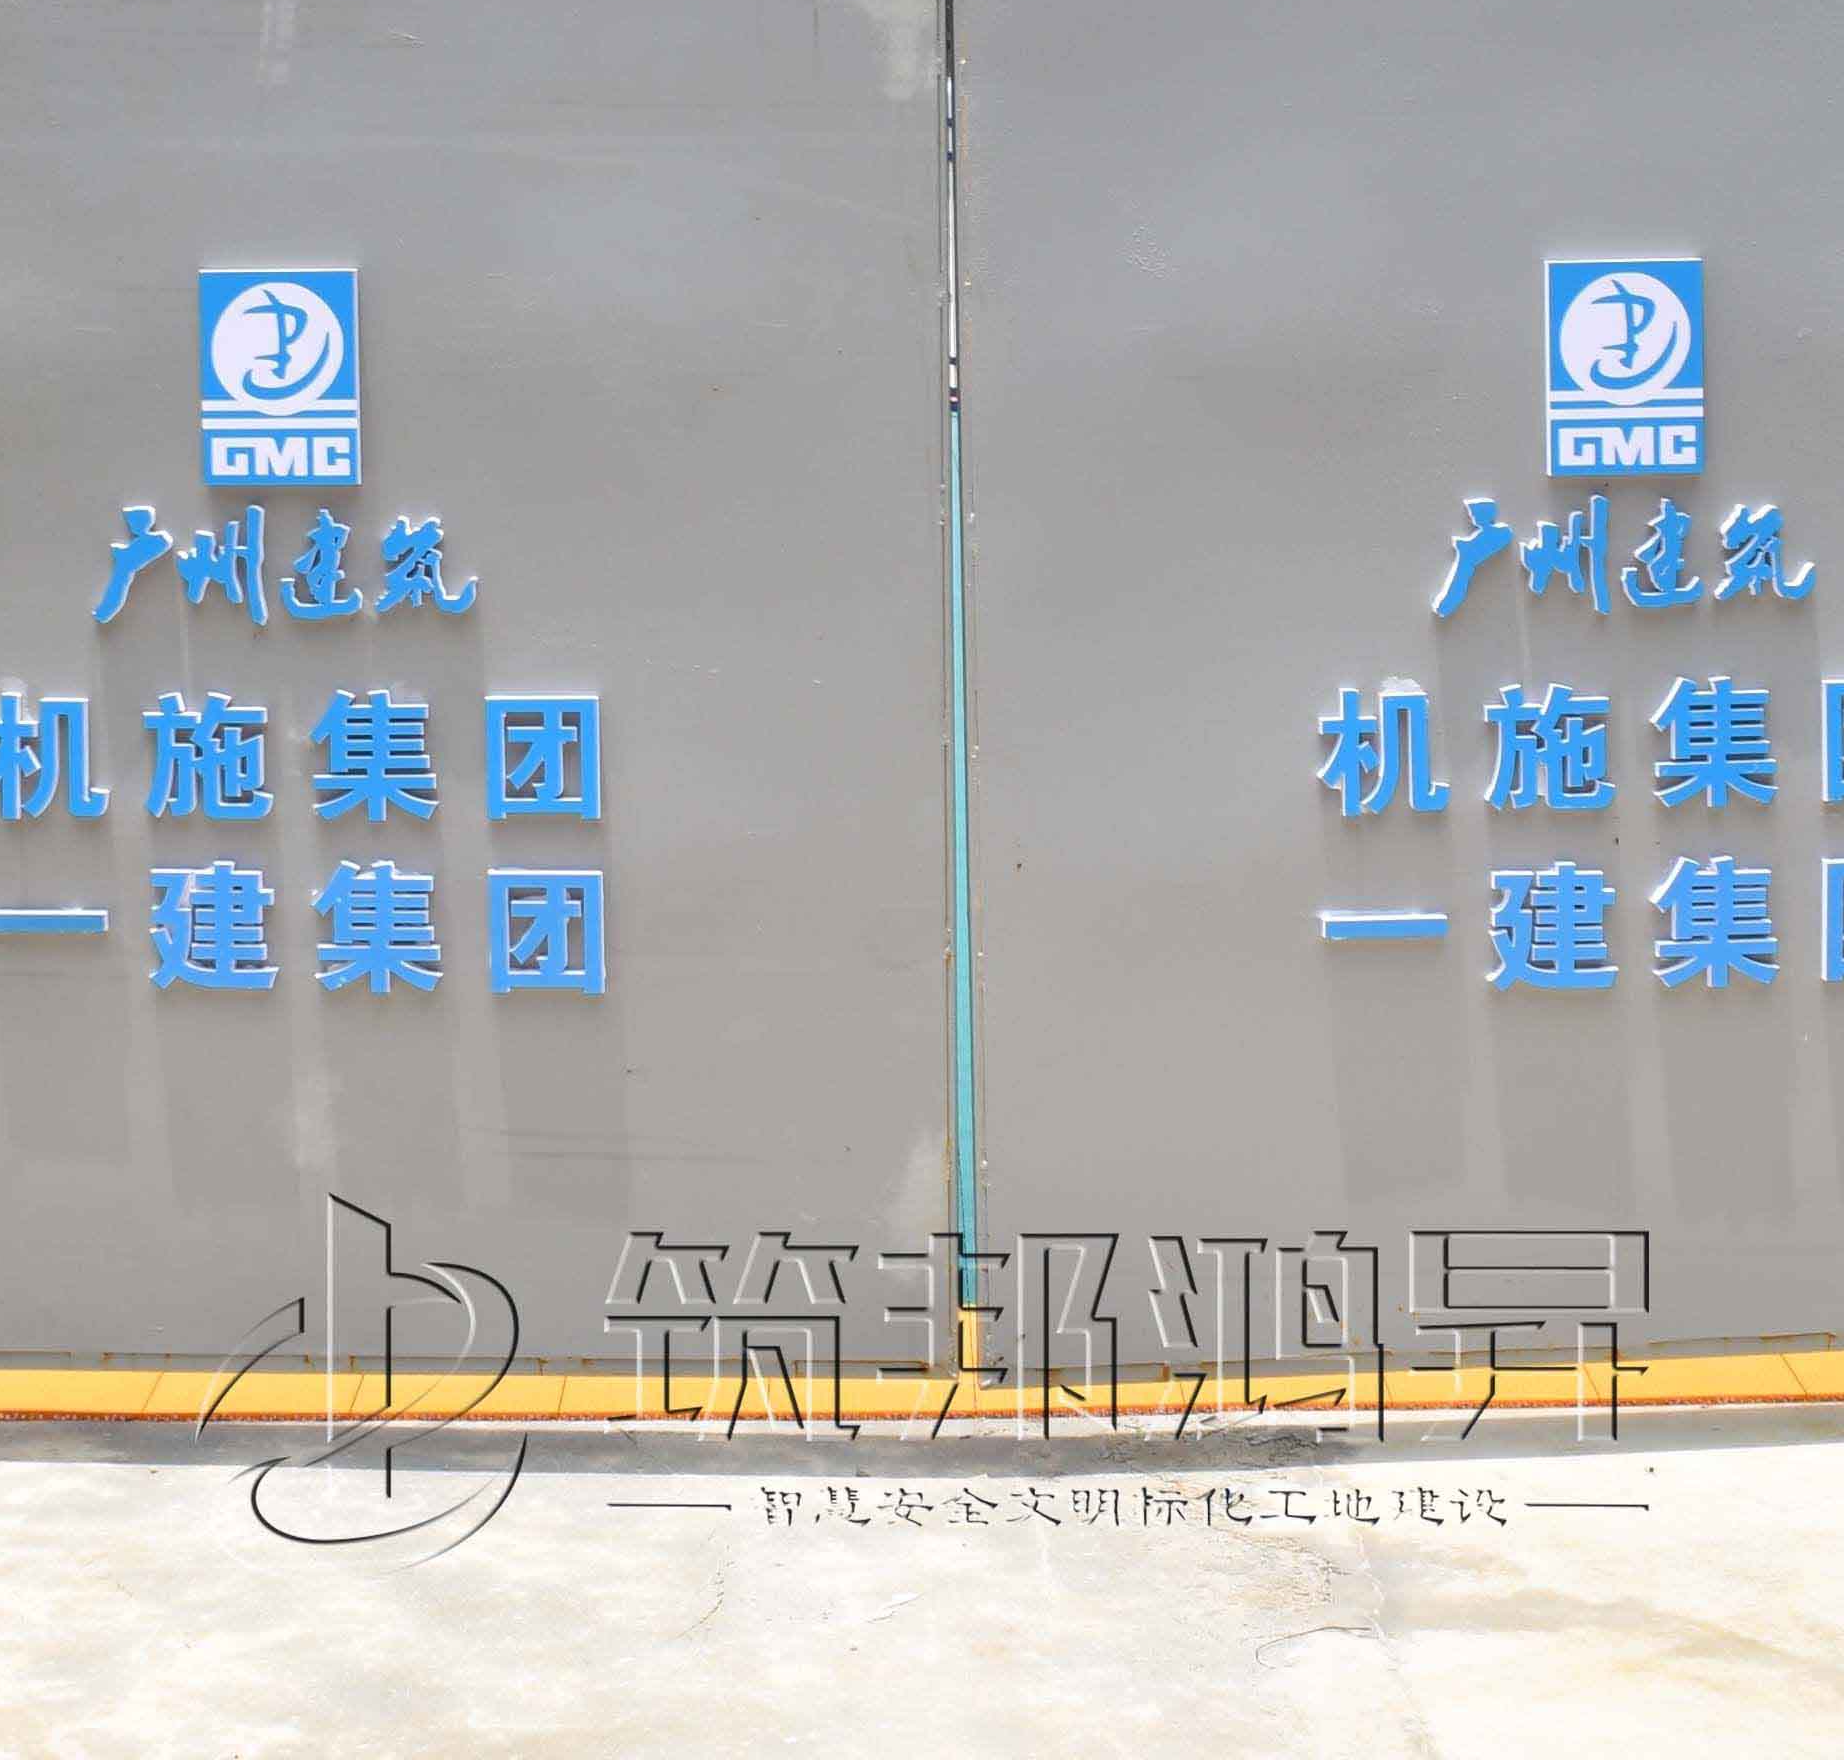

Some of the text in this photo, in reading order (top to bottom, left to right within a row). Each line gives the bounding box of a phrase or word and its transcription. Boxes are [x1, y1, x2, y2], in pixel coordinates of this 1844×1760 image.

[211, 436, 352, 478] GMC
[1559, 424, 1698, 467] GMC
[92, 505, 479, 626] 广州建筑
[1431, 494, 1816, 618] 广州建筑
